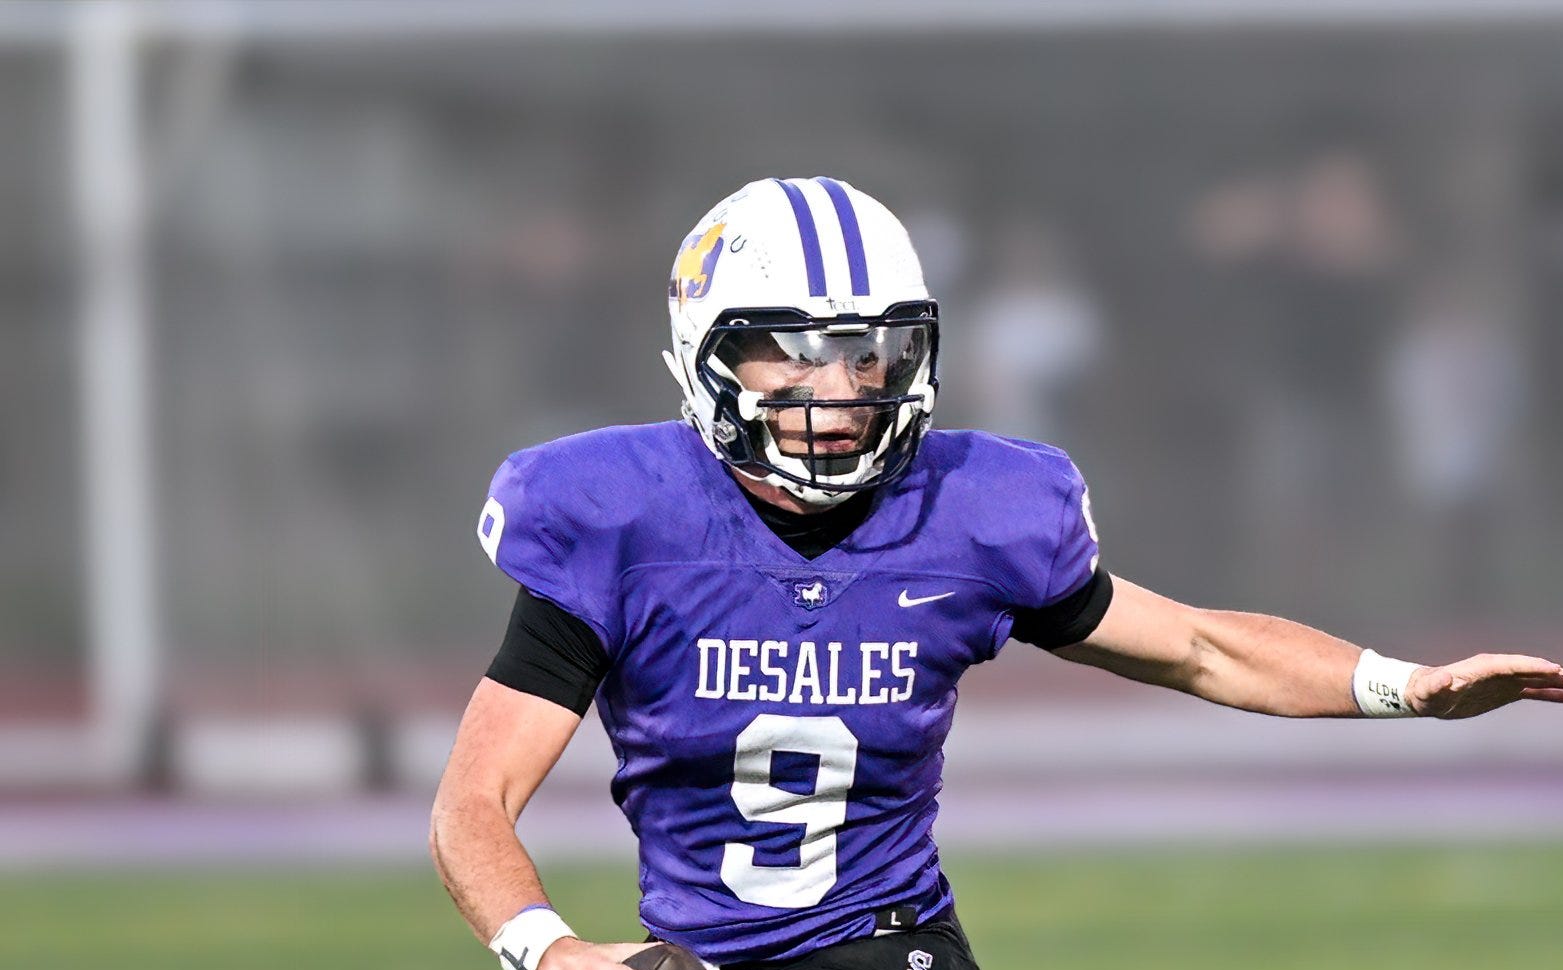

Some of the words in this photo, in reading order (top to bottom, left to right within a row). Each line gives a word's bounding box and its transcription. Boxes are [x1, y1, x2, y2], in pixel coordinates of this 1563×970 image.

[695, 638, 918, 704] DESALES
[720, 714, 858, 909] 9
[891, 911, 901, 926] L
